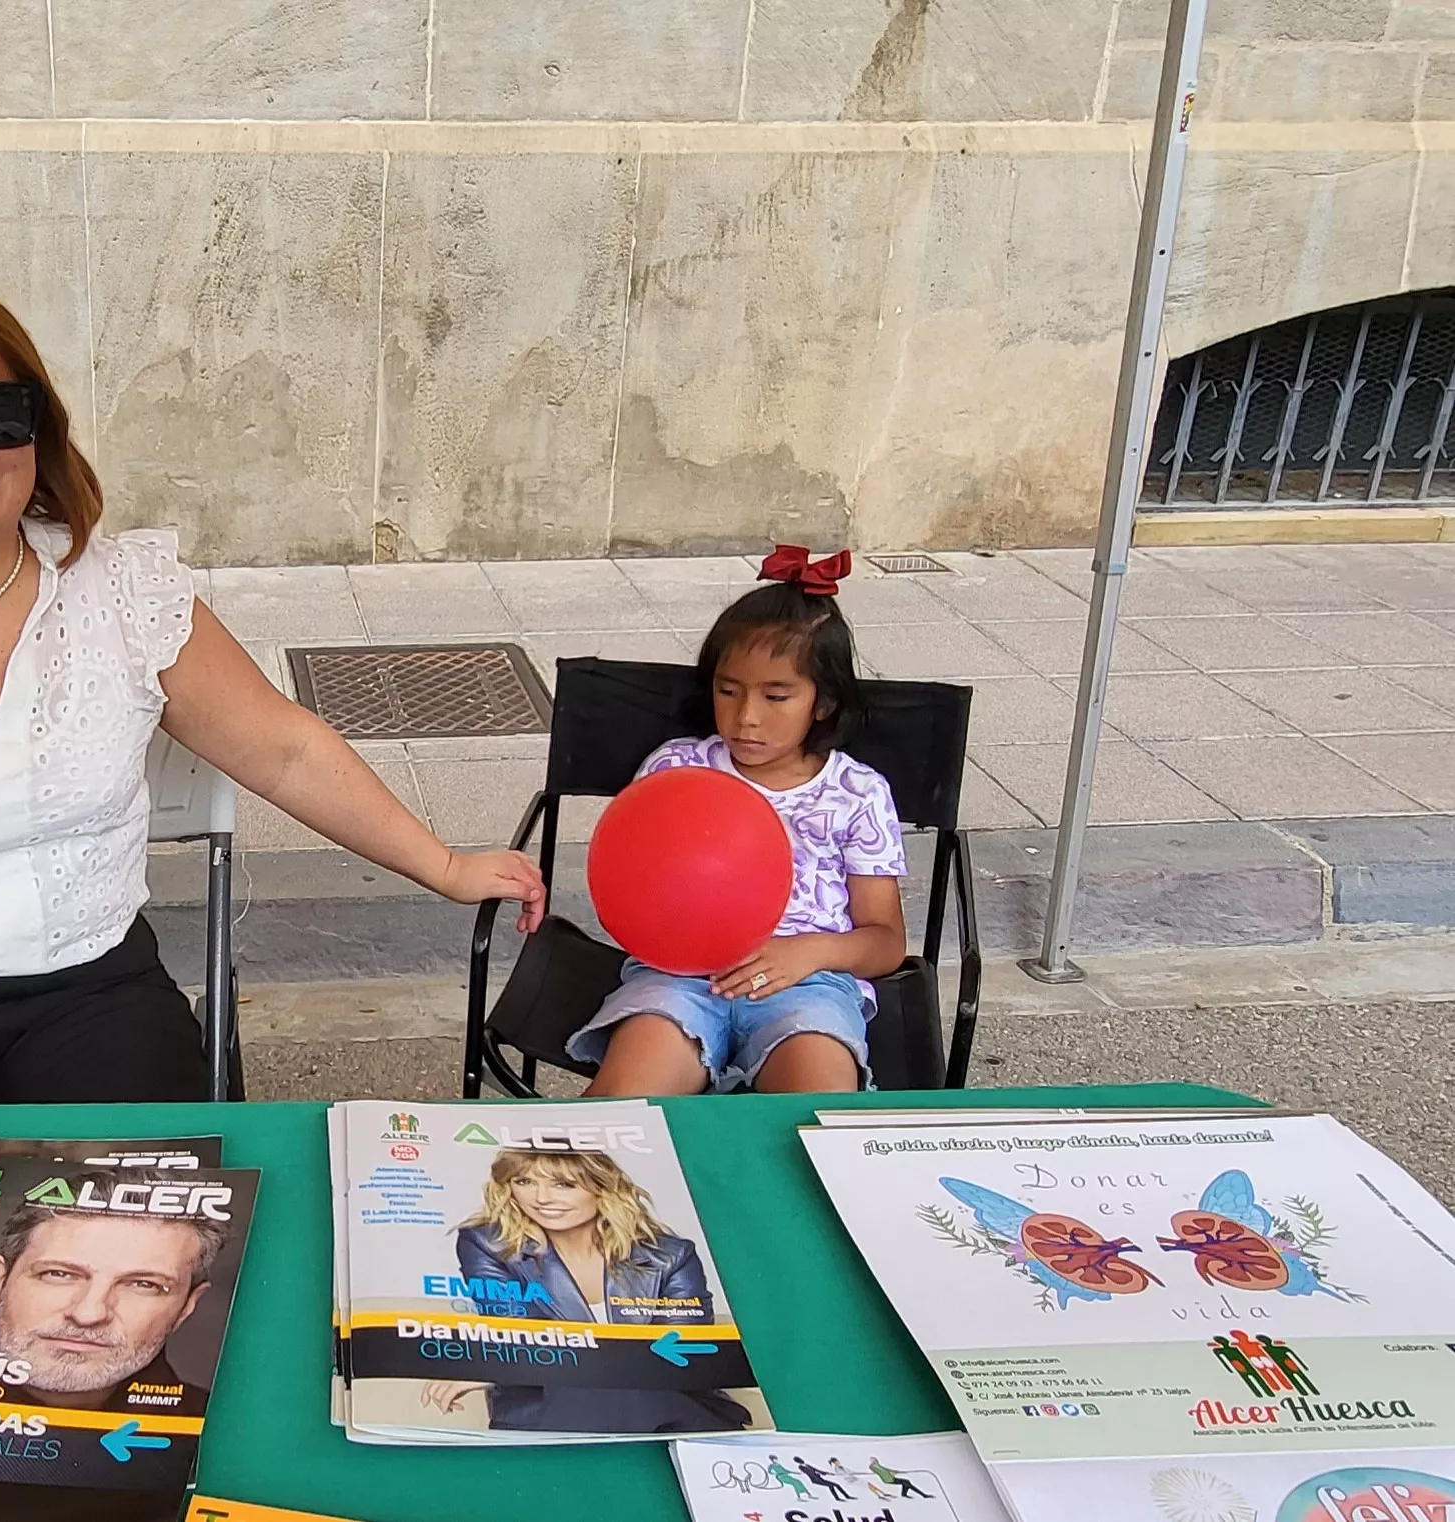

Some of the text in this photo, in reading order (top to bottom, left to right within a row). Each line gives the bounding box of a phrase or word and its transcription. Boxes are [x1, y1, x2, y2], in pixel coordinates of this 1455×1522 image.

[380, 1132, 430, 1143] ALCER
[454, 1123, 654, 1154] ALCER
[894, 1139, 937, 1152] vida
[997, 1139, 1012, 1153] y
[1013, 1137, 1066, 1151] luego
[1140, 1133, 1191, 1145] hazte
[1193, 1130, 1275, 1144] donante!
[1013, 1162, 1169, 1190] Donar
[24, 1176, 233, 1221] ALCER
[1098, 1199, 1136, 1216] es
[423, 1275, 554, 1305] EMMA
[635, 1296, 702, 1307] Nacional
[620, 1307, 705, 1318] del Trasplante
[1171, 1295, 1272, 1320] vida
[396, 1318, 599, 1349] Día Mundial
[420, 1338, 473, 1362] del
[127, 1381, 184, 1396] Annual
[1016, 1390, 1052, 1399] Antonio
[126, 1394, 182, 1407] SUMMIT
